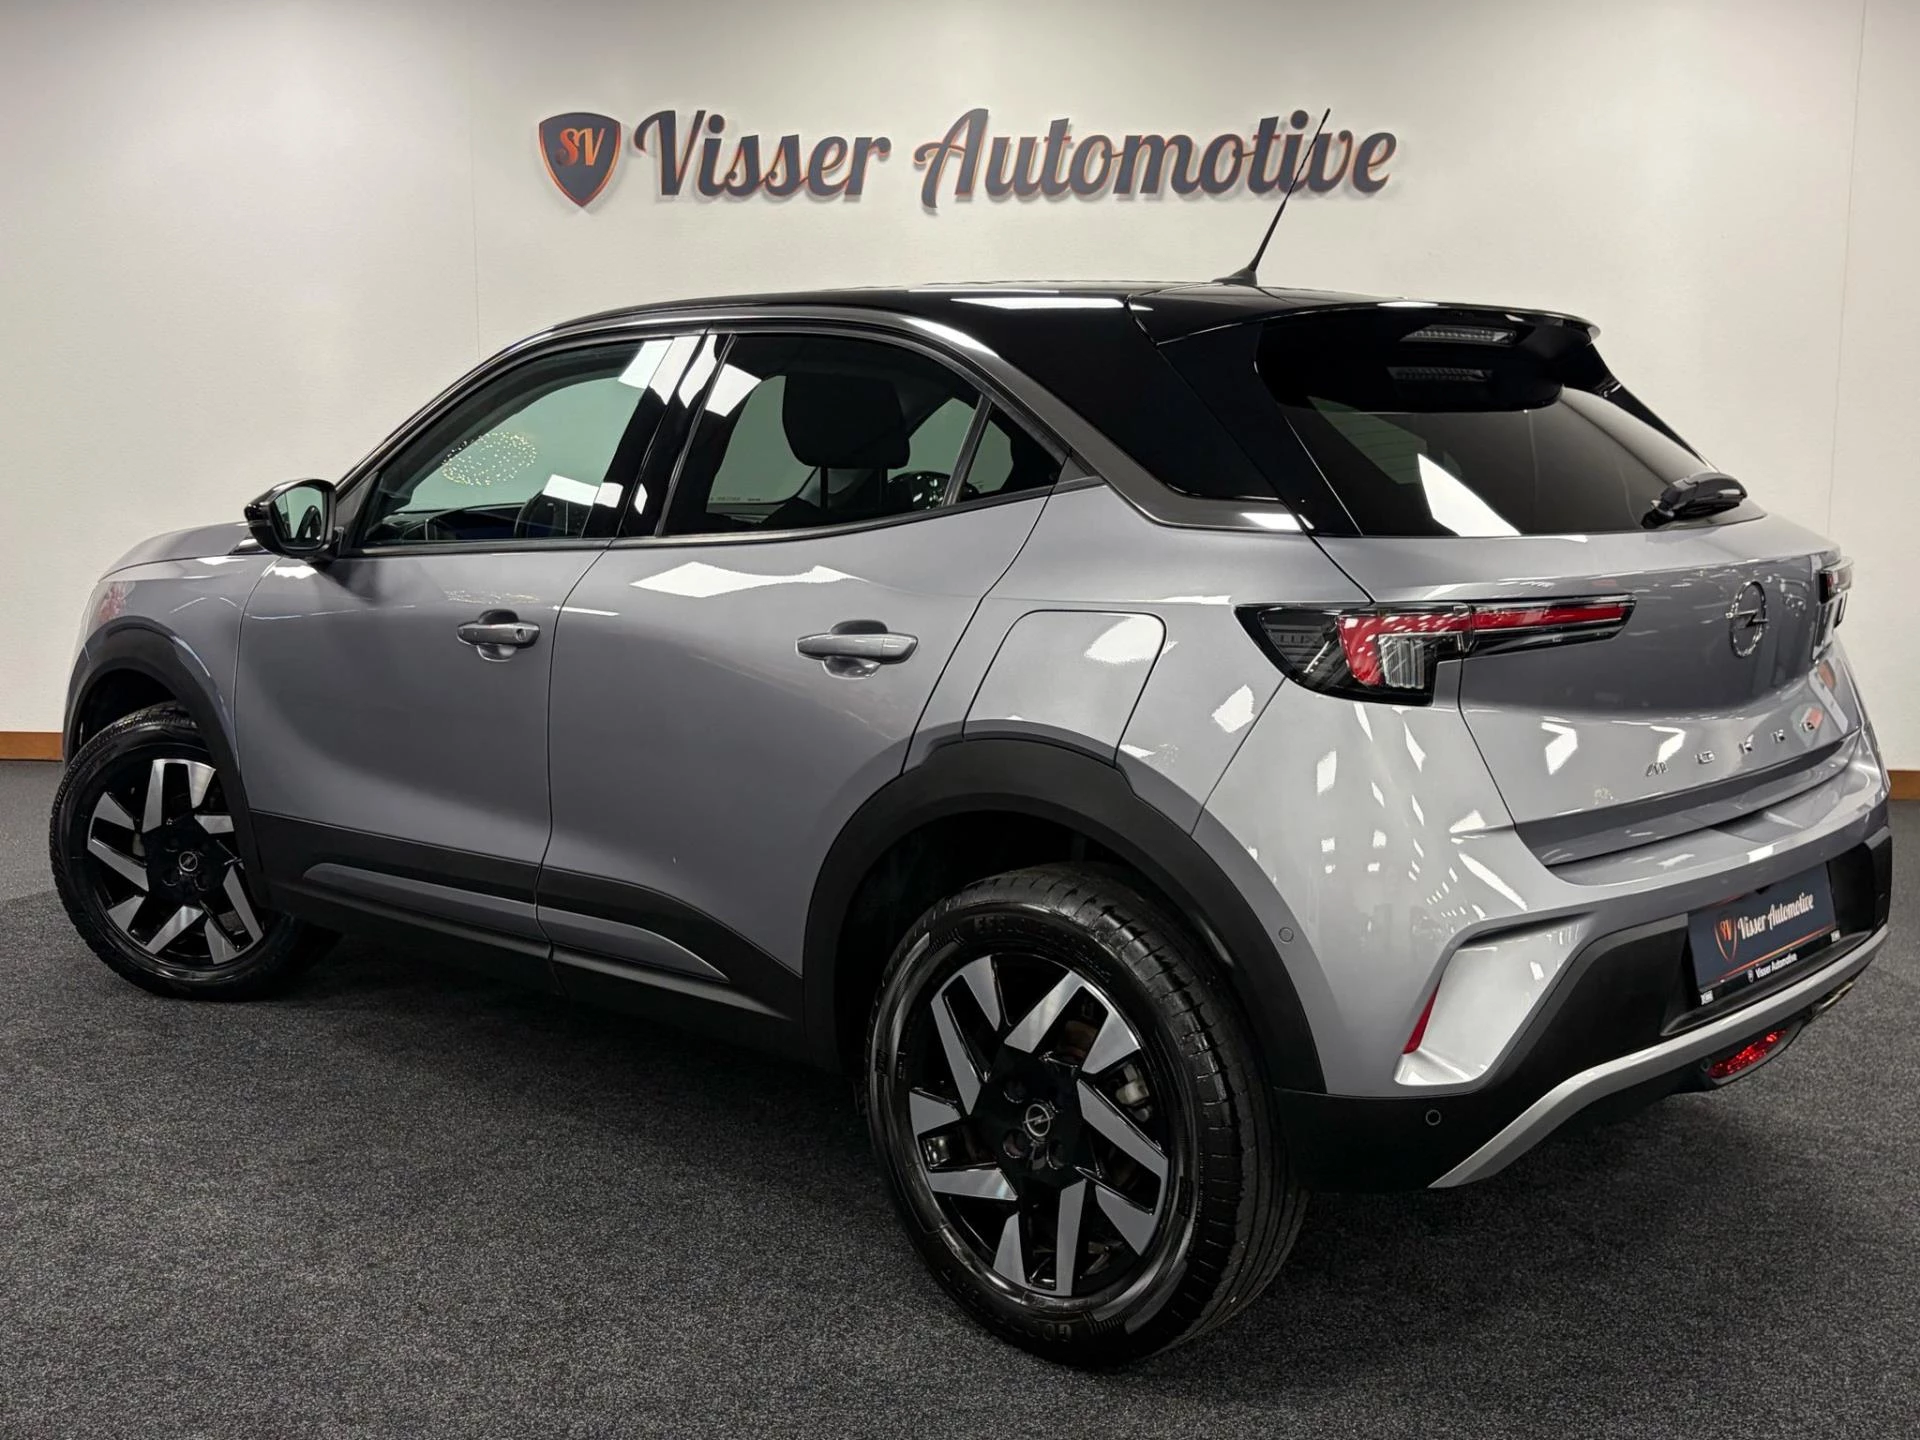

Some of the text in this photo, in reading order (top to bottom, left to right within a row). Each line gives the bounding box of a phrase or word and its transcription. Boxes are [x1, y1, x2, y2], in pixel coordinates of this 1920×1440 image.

[556, 127, 606, 167] SV
[634, 108, 1398, 208] Visser Automotive
[1737, 891, 1814, 940] Visser Automotive
